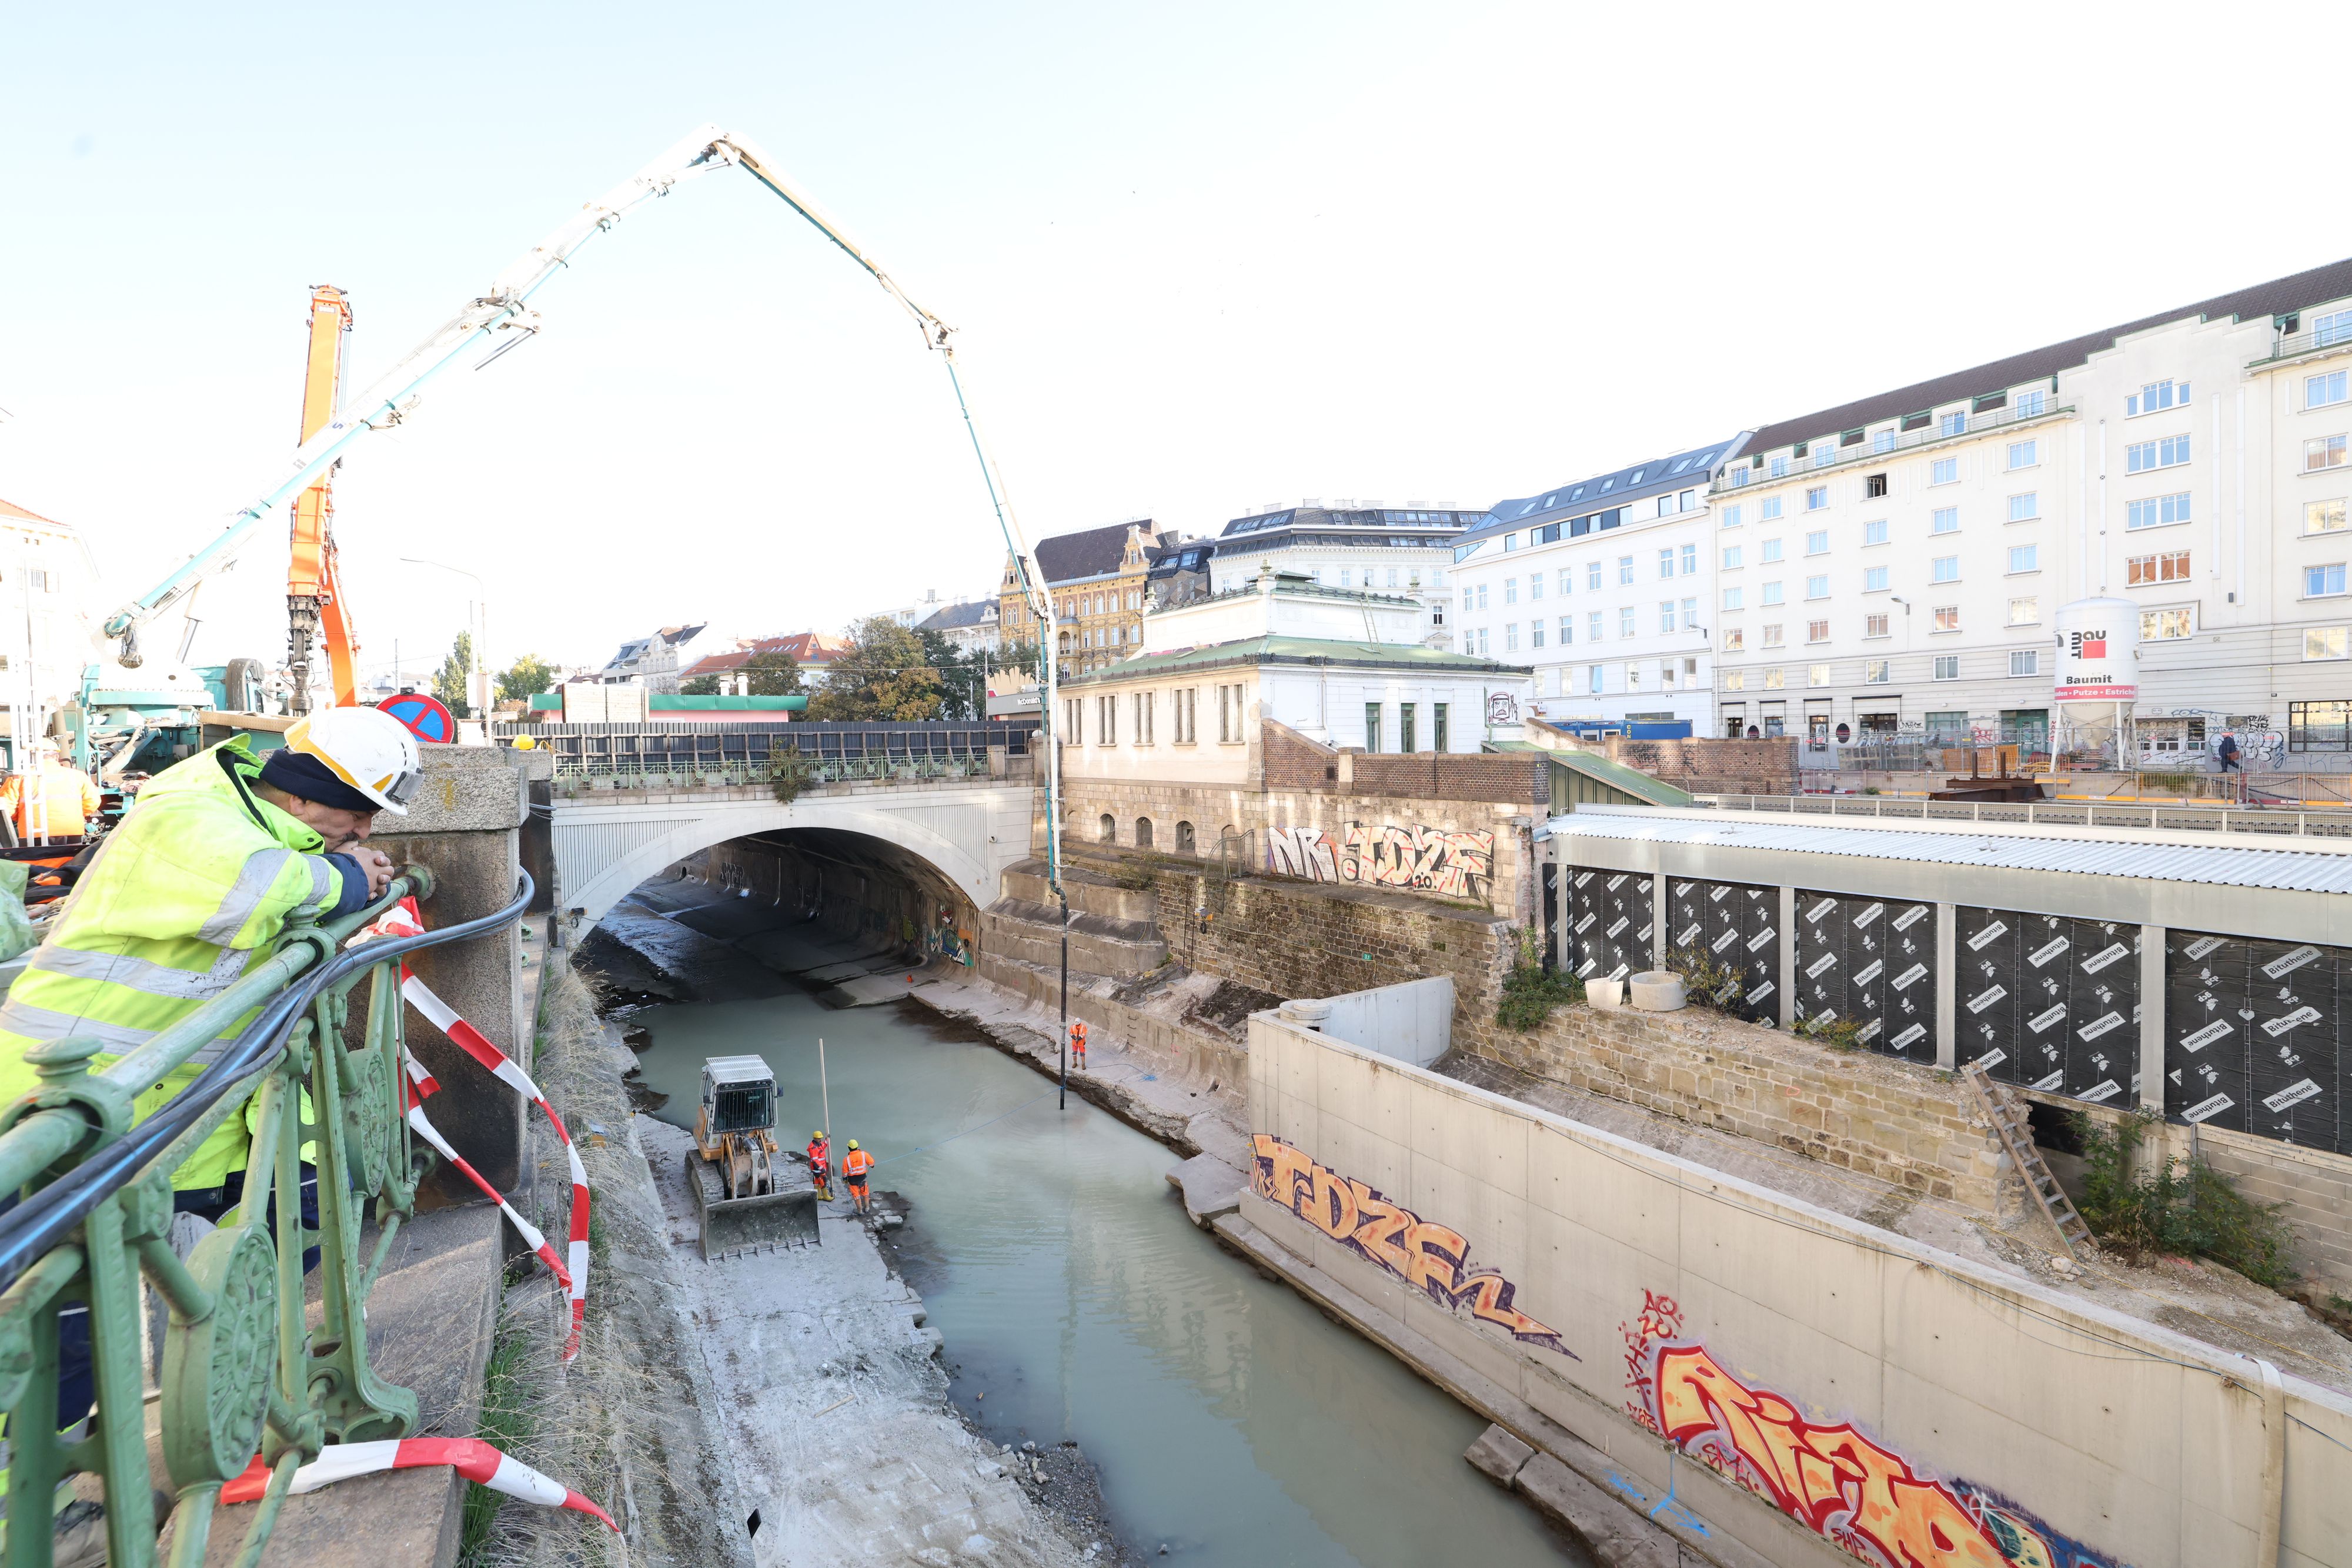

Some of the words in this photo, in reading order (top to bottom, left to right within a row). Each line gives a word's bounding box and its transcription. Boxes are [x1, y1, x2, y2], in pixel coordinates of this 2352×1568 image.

[2067, 675, 2112, 684] Baumit
[1017, 697, 1041, 706] McDonald's
[1809, 900, 1833, 920] Bituthene
[1856, 905, 1882, 925] Bituthene
[1896, 907, 1924, 928] Bituthene
[1578, 914, 1595, 931] Bituthene
[1609, 918, 1628, 935] Bituthene
[1680, 925, 1699, 944] Bituthene
[1715, 931, 1736, 950] Bituthene
[1750, 930, 1773, 947] Bituthene
[1818, 935, 1826, 944] gcp
[1973, 924, 2003, 946] Bituthene
[1866, 941, 1876, 950] gcp
[1906, 945, 1916, 954] gcp
[2033, 940, 2067, 962] Bituthene
[1809, 955, 1833, 975] Bituthene
[1980, 960, 1992, 971] gcp
[2087, 945, 2124, 969] Bituthene
[2268, 949, 2314, 975] Bituthene
[1856, 962, 1882, 984] Bituthene
[1895, 967, 1922, 988] Bituthene
[2204, 975, 2219, 987] gcp
[2042, 978, 2054, 988] gcp
[2095, 985, 2109, 995] gcp
[1749, 984, 1772, 1000] Bituthene
[1817, 991, 1826, 999] gcp
[1972, 988, 2003, 1009] Bituthene
[2197, 991, 2213, 1002] gcp
[1866, 999, 1876, 1008] gcp
[1904, 1004, 1915, 1014] gcp
[2033, 1005, 2066, 1028] Bituthene
[1980, 1024, 1992, 1034] gcp
[2083, 1015, 2120, 1036] Bituthene
[1893, 1027, 1922, 1047] Bituthene
[2188, 1023, 2227, 1047] Bituthene
[2042, 1044, 2054, 1054] gcp
[2092, 1053, 2105, 1063] gcp
[2284, 1055, 2300, 1065] gcp
[2199, 1065, 2213, 1075] gcp
[2269, 1084, 2313, 1109] Bituthene
[2189, 1096, 2229, 1119] Bituthene
